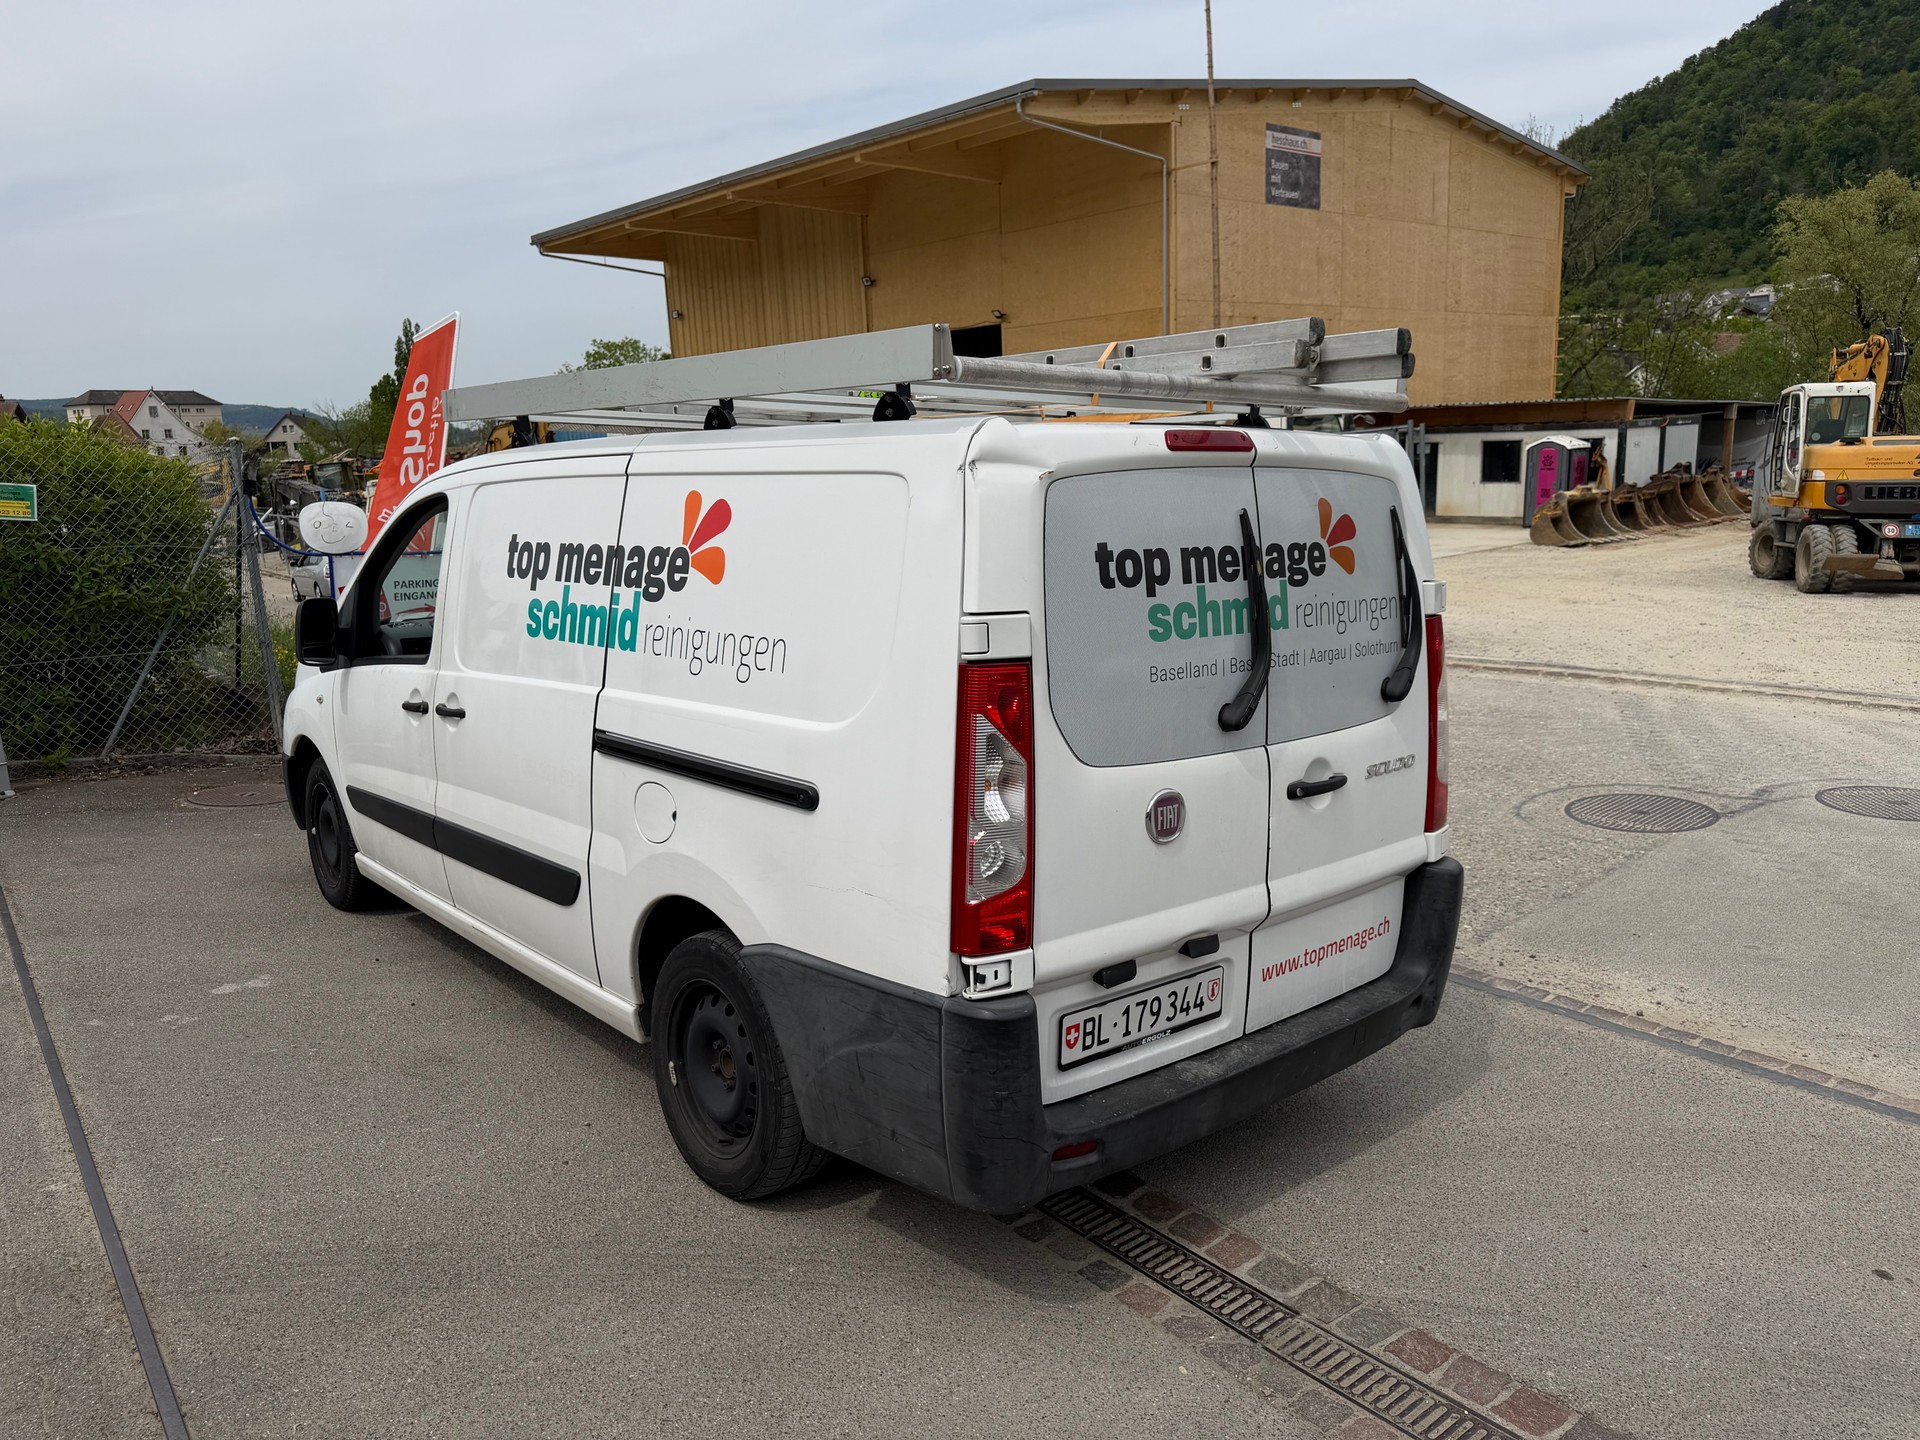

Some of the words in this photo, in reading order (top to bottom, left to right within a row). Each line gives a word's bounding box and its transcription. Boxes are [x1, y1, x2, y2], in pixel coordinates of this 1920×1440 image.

[1864, 486, 1920, 499] LIEB
[506, 533, 551, 591] top
[555, 543, 690, 602] menage
[1095, 542, 1171, 597] top
[526, 585, 642, 652] schmid
[643, 615, 787, 683] reinigungen
[1147, 577, 1290, 642] schmd
[1295, 593, 1399, 634] reinigungen
[1149, 660, 1218, 683] Baselland
[1309, 646, 1347, 665] Aargau
[1354, 639, 1399, 658] Solothurn
[1157, 803, 1180, 831] FIAT
[1261, 916, 1391, 982] www.topmenage.ch
